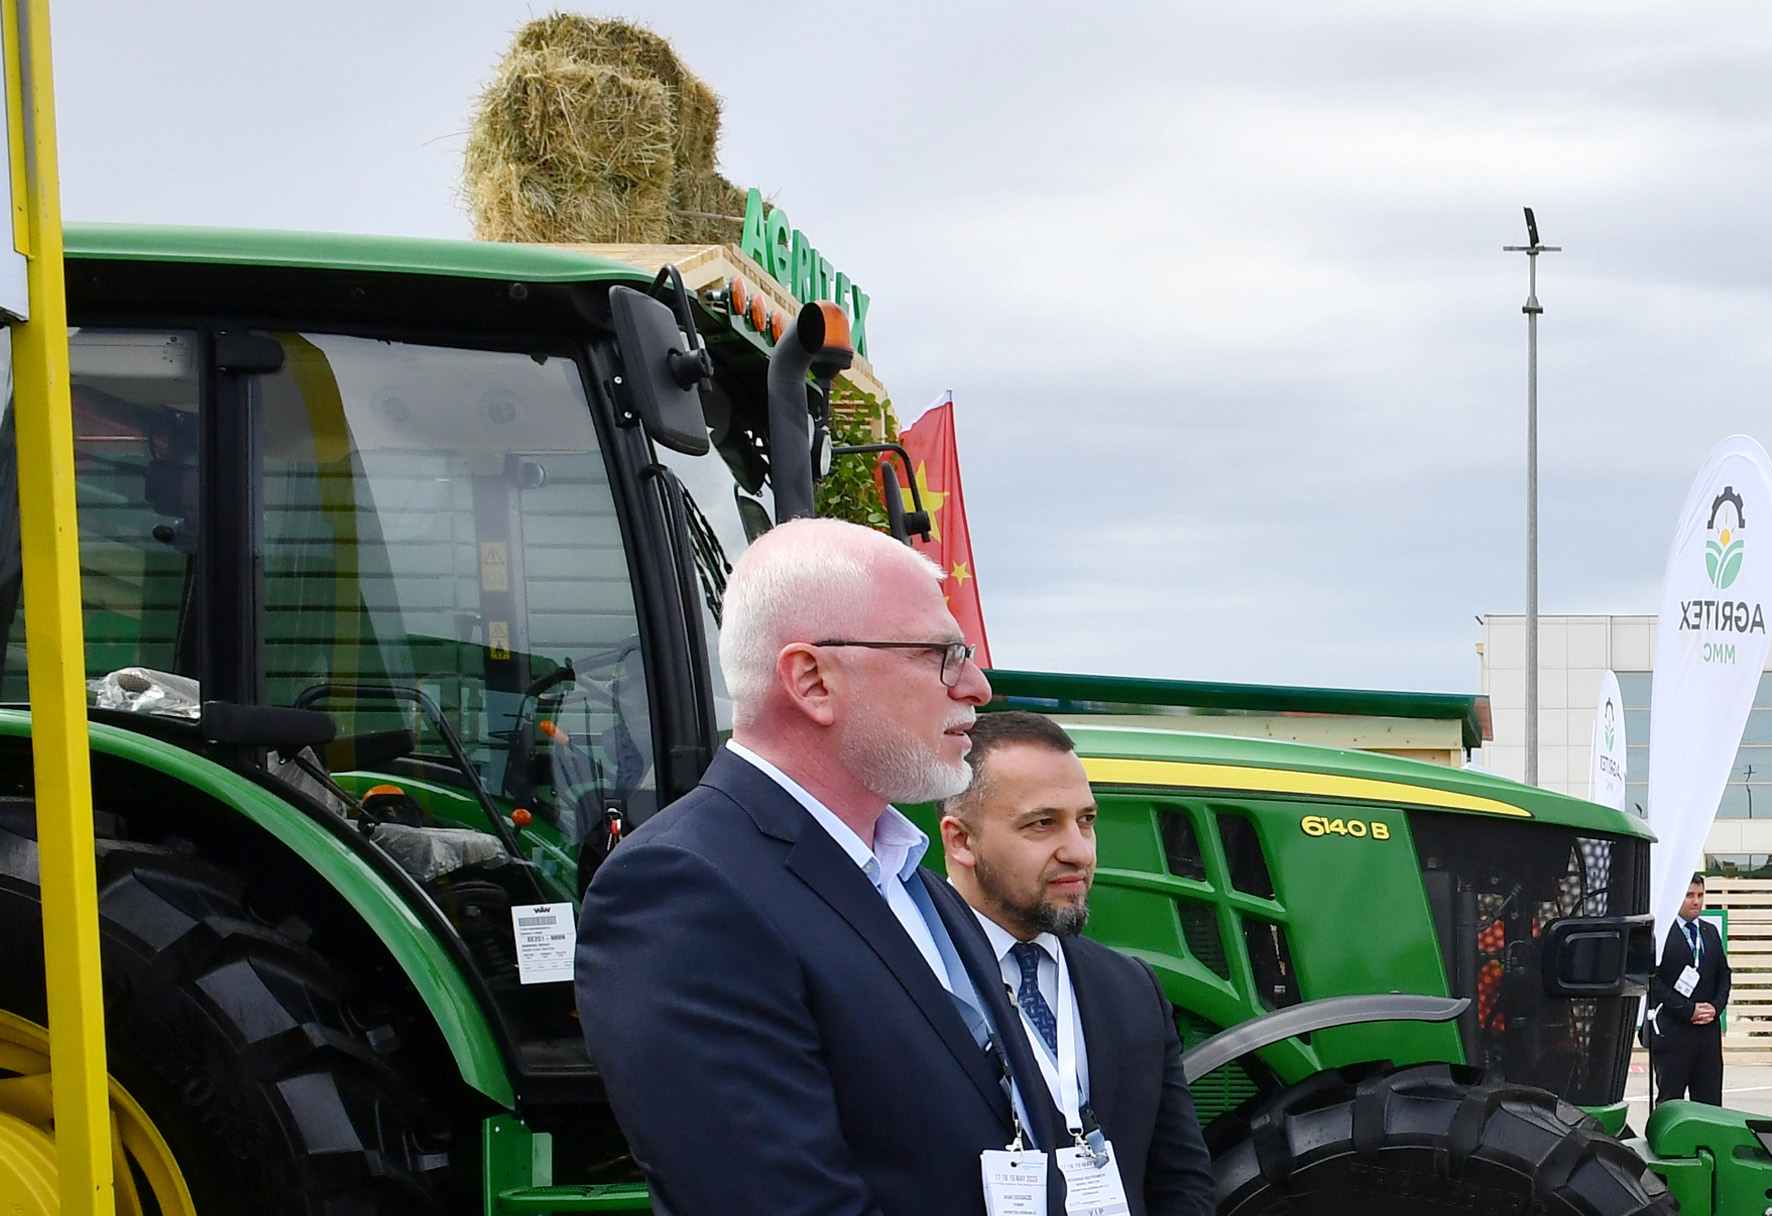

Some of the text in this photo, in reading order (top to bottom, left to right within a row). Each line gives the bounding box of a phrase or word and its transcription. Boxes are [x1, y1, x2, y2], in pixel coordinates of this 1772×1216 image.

[741, 187, 871, 360] AGRITEX
[1301, 815, 1391, 840] 6140 B
[1088, 1208, 1104, 1216] VIP
